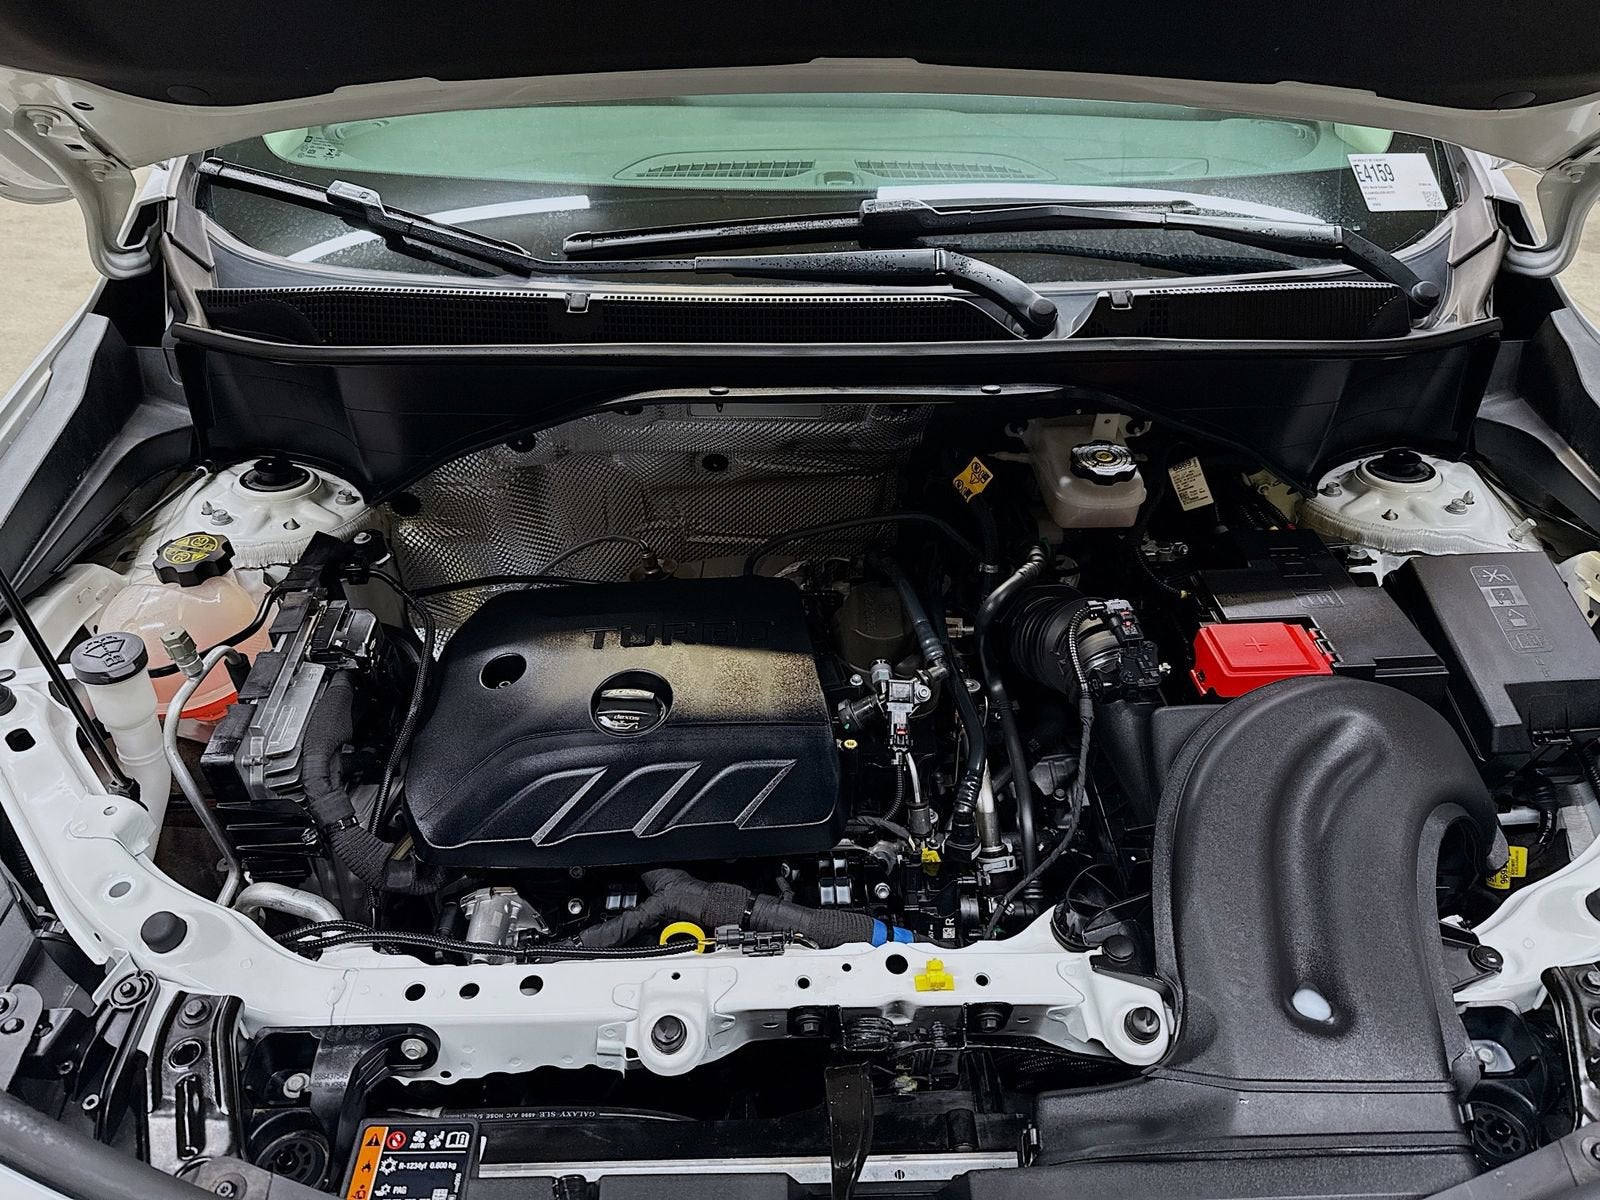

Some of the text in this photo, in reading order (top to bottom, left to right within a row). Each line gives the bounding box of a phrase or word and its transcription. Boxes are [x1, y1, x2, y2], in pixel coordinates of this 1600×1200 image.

[1354, 163, 1395, 183] E4159
[583, 621, 776, 650] TURBO
[409, 1142, 426, 1150] AUTO
[398, 1161, 429, 1171] R-1234yf
[448, 1161, 457, 1171] kg
[392, 1186, 408, 1194] PAG
